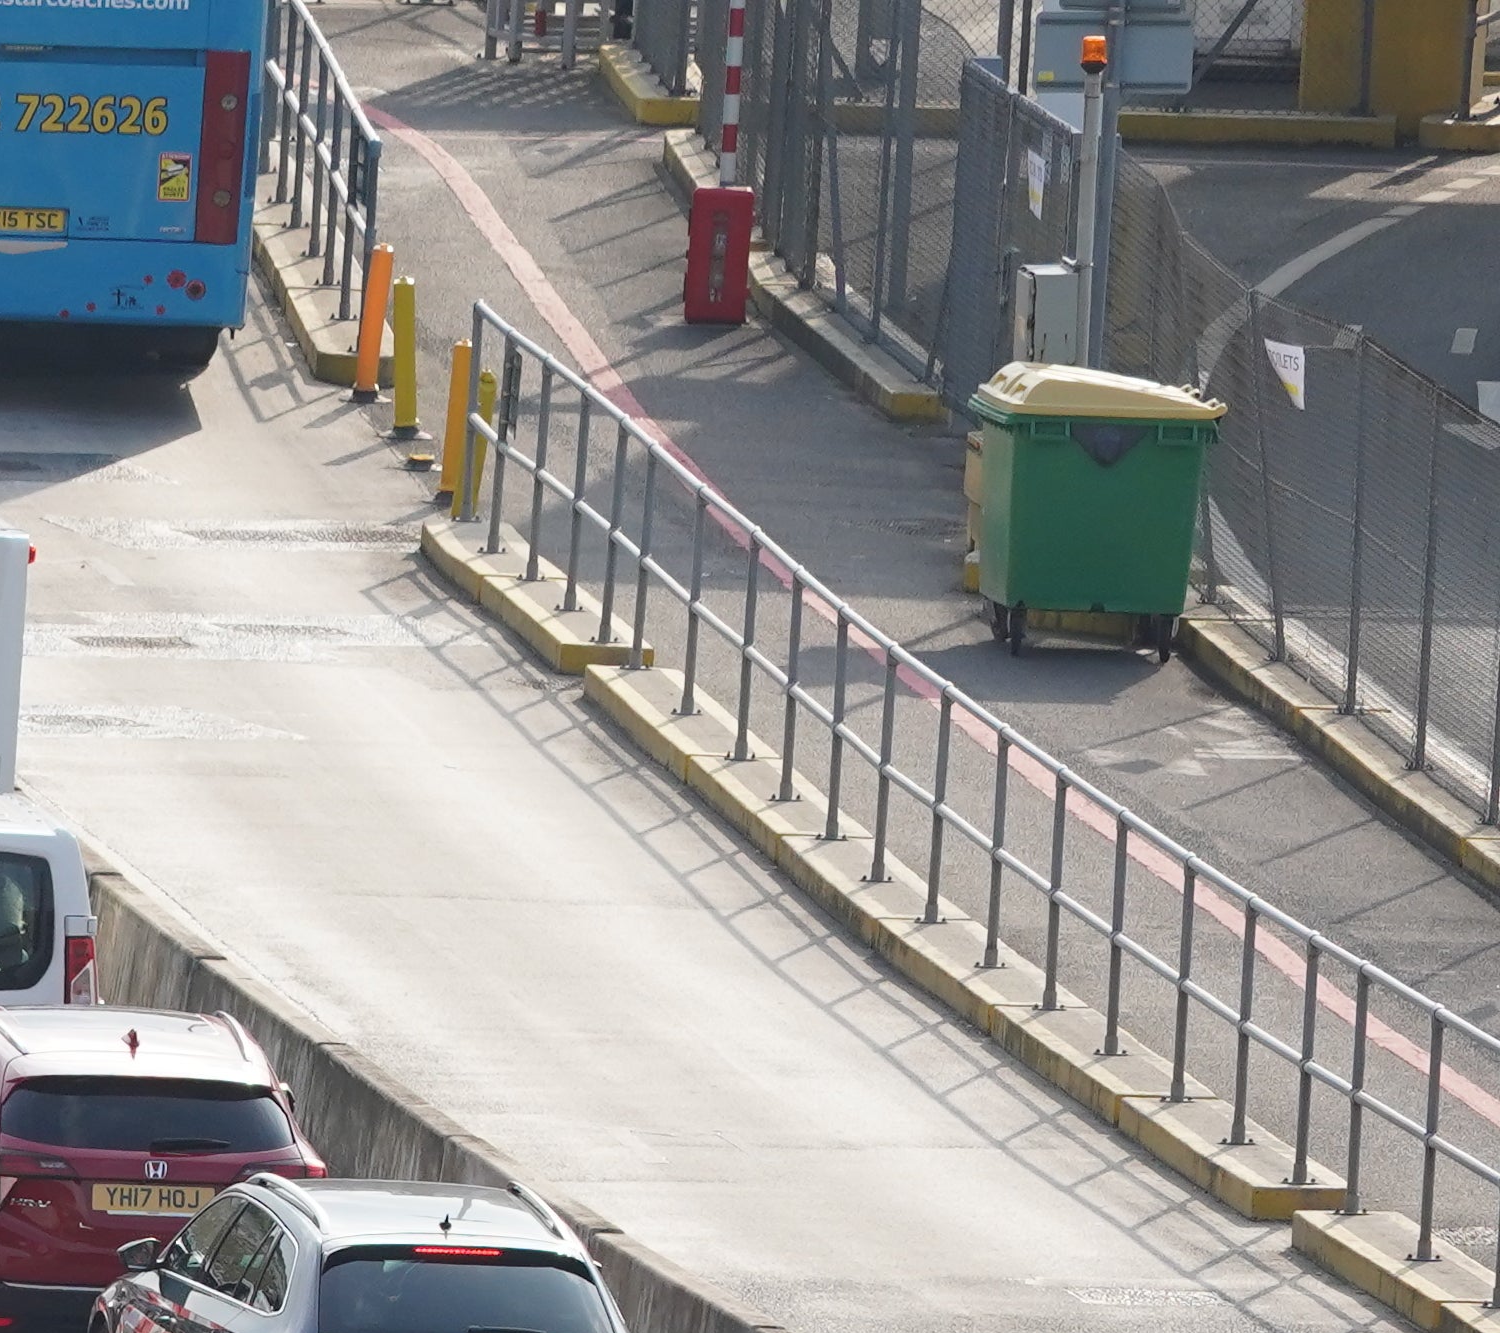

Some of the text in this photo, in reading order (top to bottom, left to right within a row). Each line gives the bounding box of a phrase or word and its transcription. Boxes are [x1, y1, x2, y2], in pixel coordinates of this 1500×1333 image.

[14, 92, 166, 136] 722626
[25, 213, 58, 229] TSC
[106, 1187, 201, 1209] YH17 HOJ
